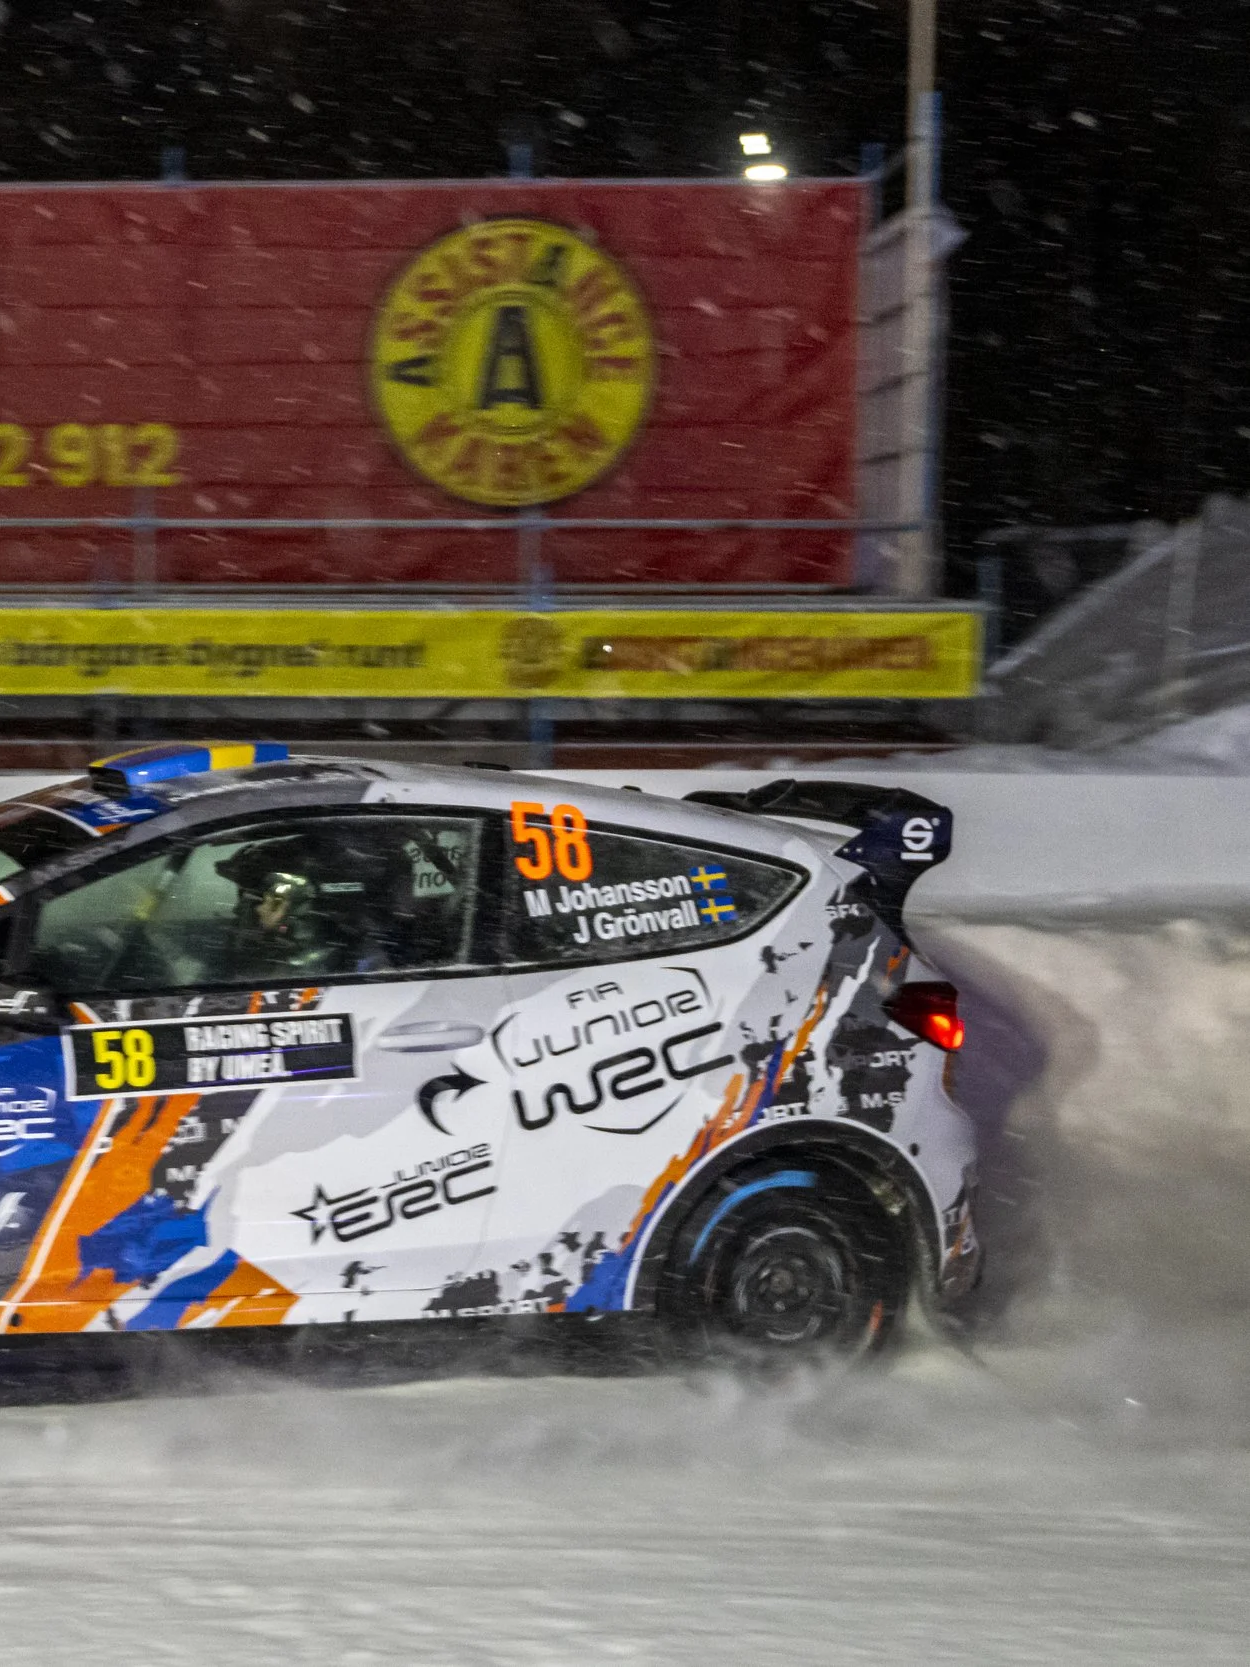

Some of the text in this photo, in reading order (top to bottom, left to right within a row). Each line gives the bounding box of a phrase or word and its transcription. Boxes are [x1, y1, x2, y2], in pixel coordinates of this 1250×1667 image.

[474, 303, 544, 411] A
[45, 423, 180, 487] 912
[509, 800, 593, 881] 58
[523, 874, 692, 917] M Johansson
[573, 900, 701, 945] J Grönvall
[567, 981, 624, 1009] FIA
[92, 1029, 156, 1089] 58
[270, 1018, 343, 1046] SPIRIT
[513, 989, 702, 1067] JUNIOR
[512, 1021, 735, 1131] WRC
